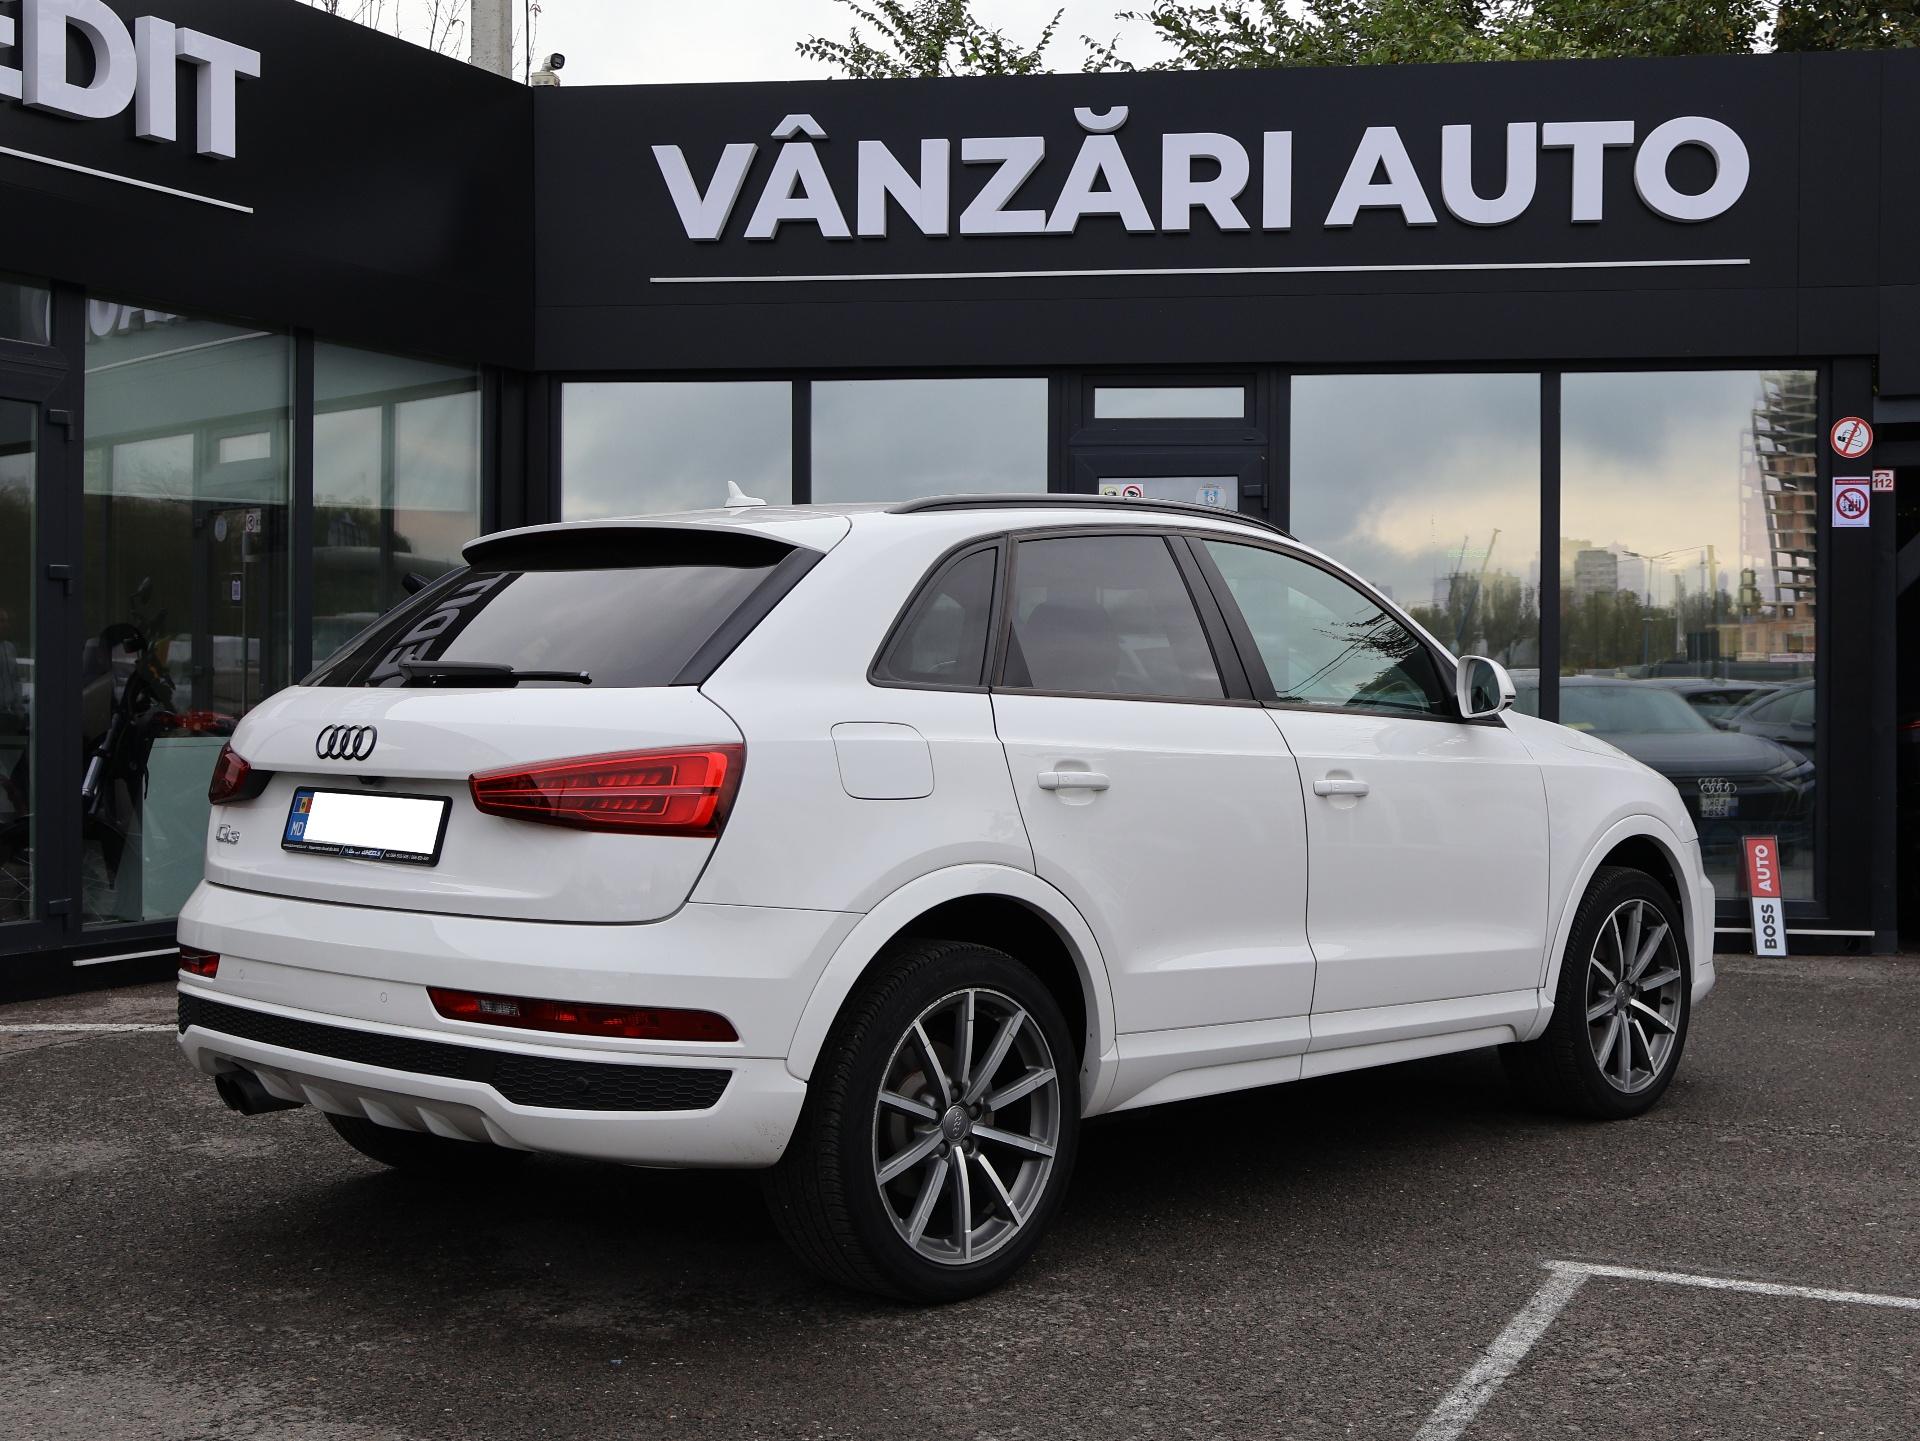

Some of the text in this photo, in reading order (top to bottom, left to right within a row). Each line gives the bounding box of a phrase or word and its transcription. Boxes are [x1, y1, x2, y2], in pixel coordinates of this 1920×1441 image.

[651, 105, 1750, 241] VÂNZĂRI AUTO
[1872, 478, 1893, 489] 112
[216, 823, 240, 845] Q3
[290, 821, 304, 836] MD
[1754, 844, 1778, 949] BOSS AUTO
